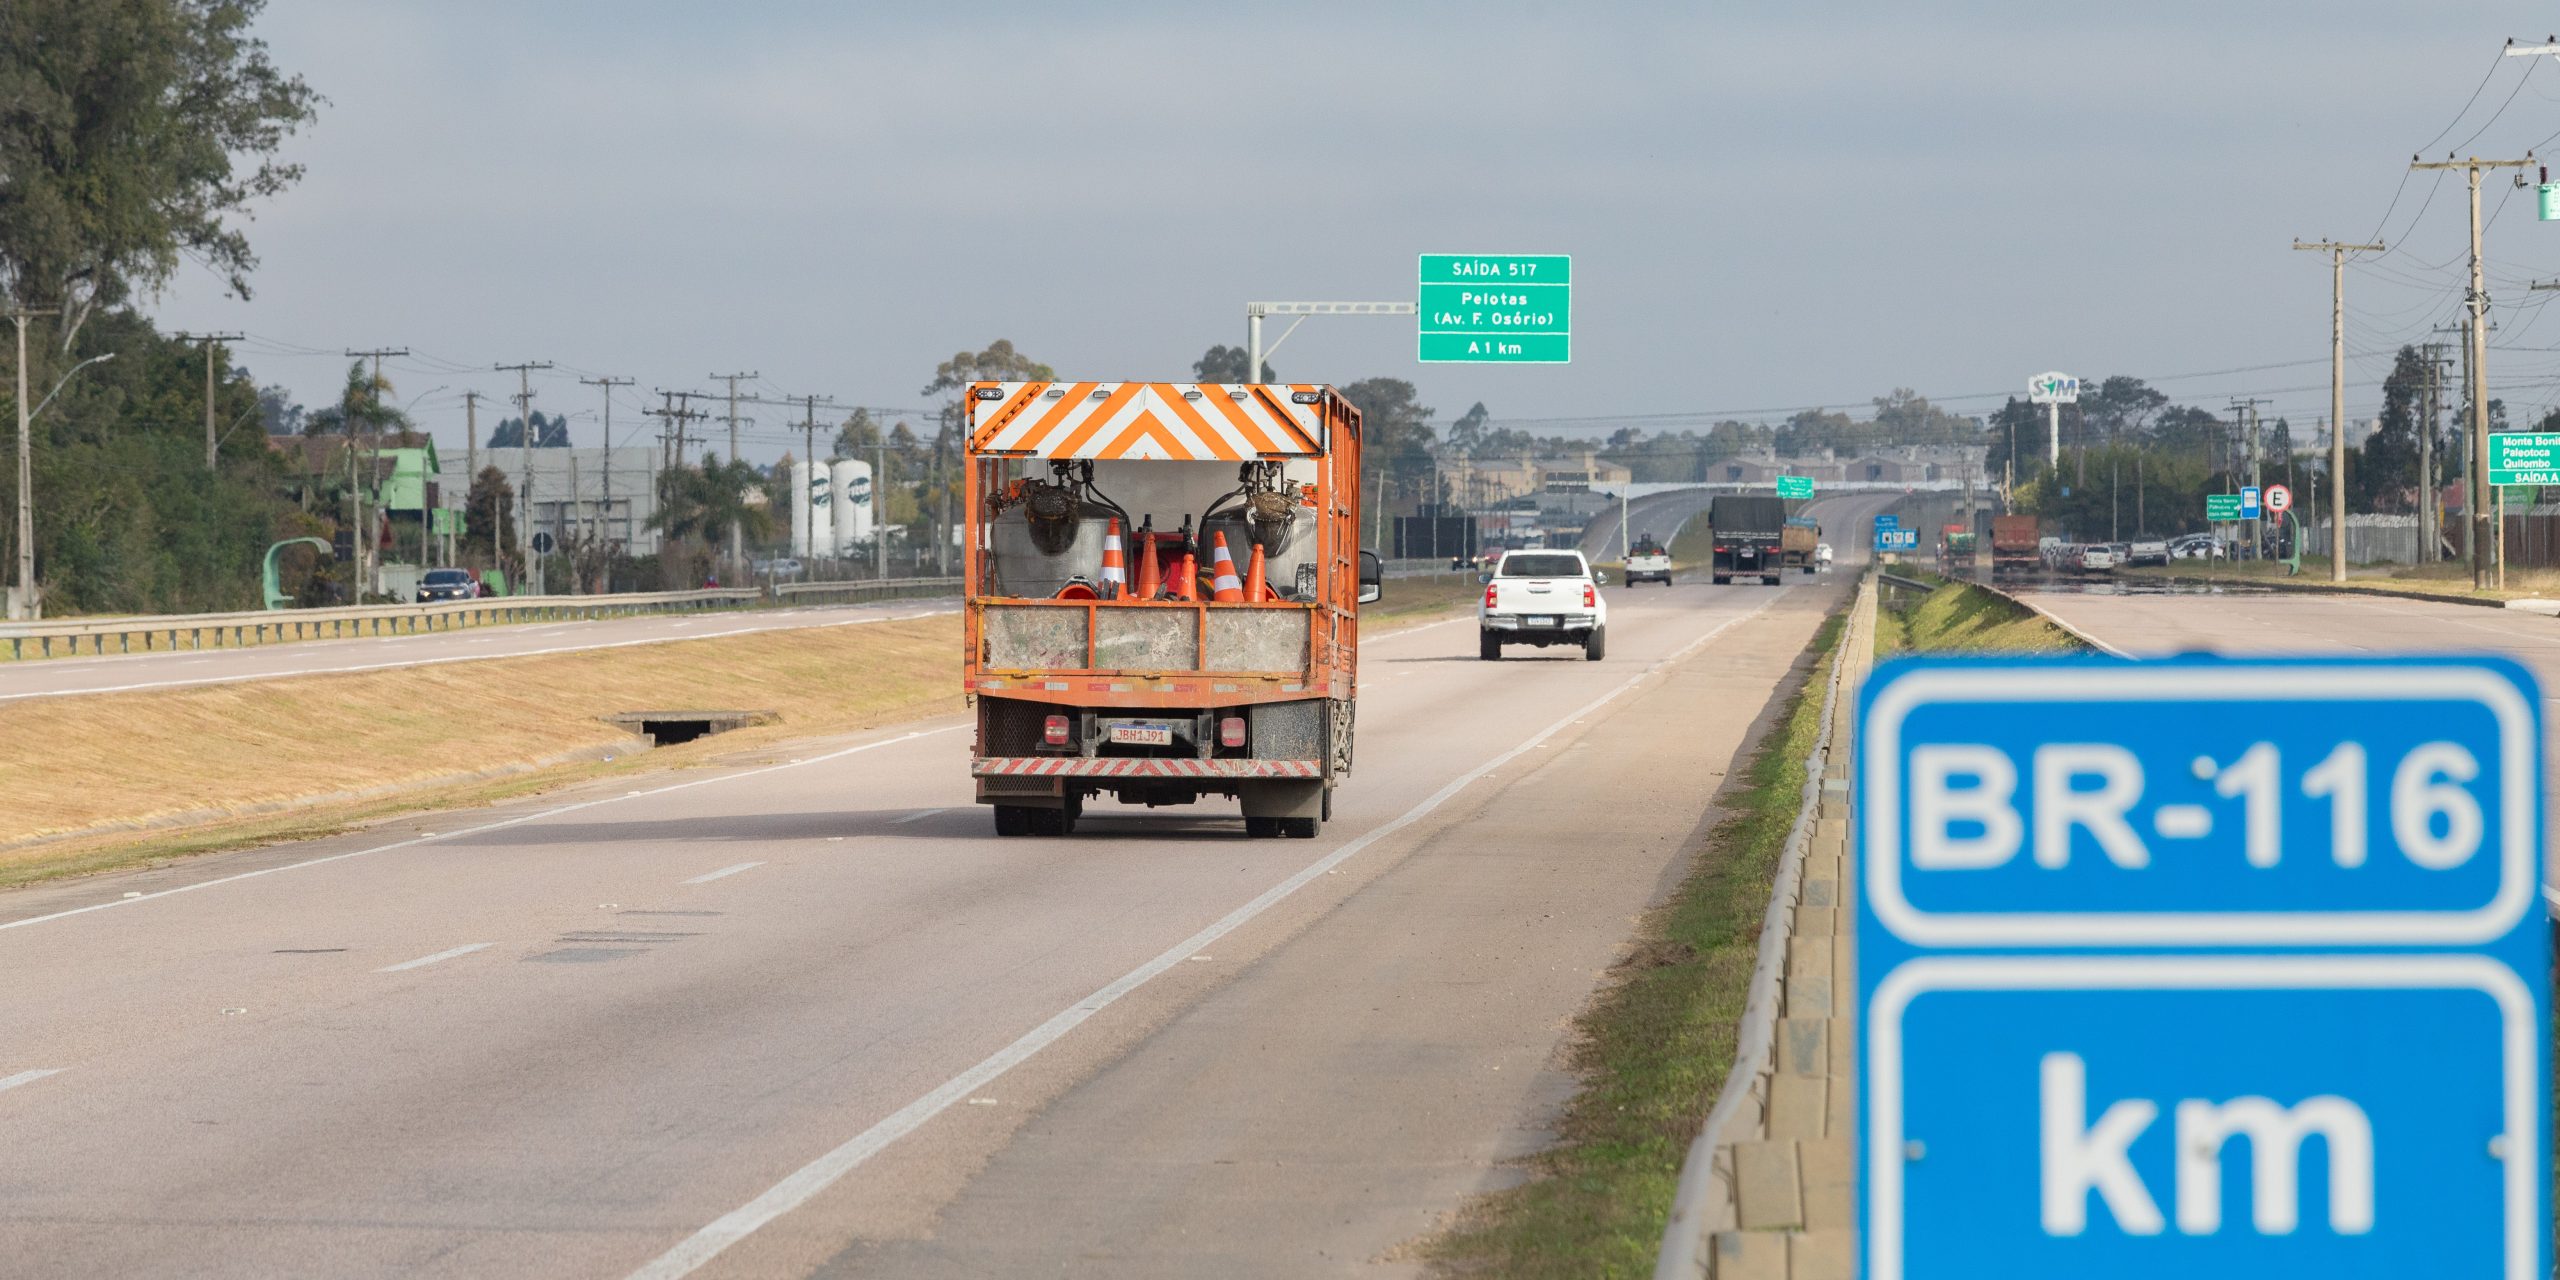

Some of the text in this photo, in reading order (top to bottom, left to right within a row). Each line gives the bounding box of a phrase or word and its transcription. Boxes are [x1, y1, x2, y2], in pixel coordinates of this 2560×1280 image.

[1452, 260, 1537, 276] SAÍDA 517
[1461, 292, 1528, 305] Pelotas
[1434, 311, 1553, 325] (Av. F. Osório)
[1468, 341, 1522, 355] A 1 km
[2503, 437, 2533, 446] Monte
[2503, 458, 2551, 469] Quilombo
[2515, 470, 2559, 483] SAÍDA A
[2273, 491, 2283, 506] E
[1908, 739, 2485, 872] BR-116
[2039, 1050, 2376, 1237] km
